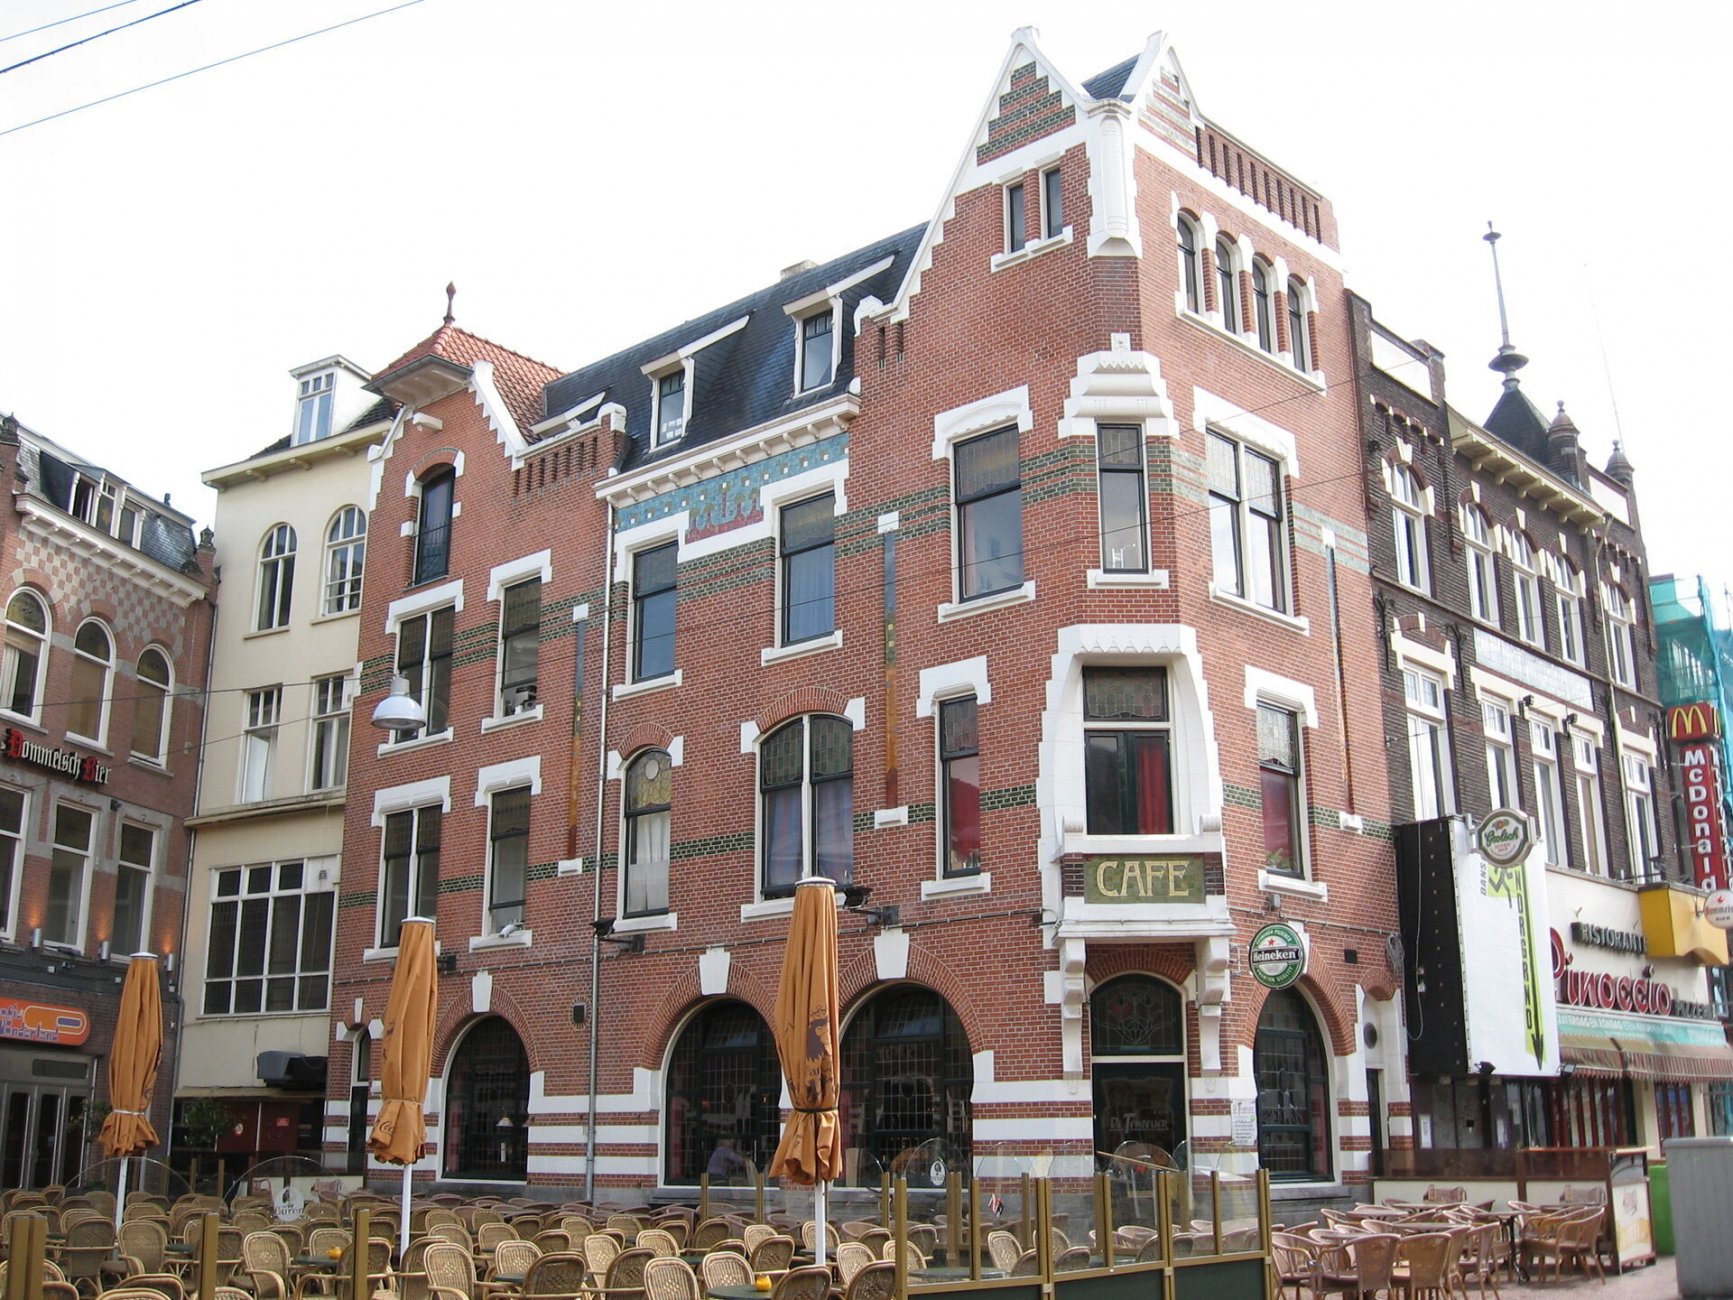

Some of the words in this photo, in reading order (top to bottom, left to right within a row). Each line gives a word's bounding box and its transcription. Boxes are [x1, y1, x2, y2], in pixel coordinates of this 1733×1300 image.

[6, 728, 81, 780] Dommelsch
[83, 756, 112, 784] Bier
[1485, 826, 1519, 847] Grolsch
[1096, 861, 1190, 896] CAFE
[1253, 949, 1297, 962] Heineken
